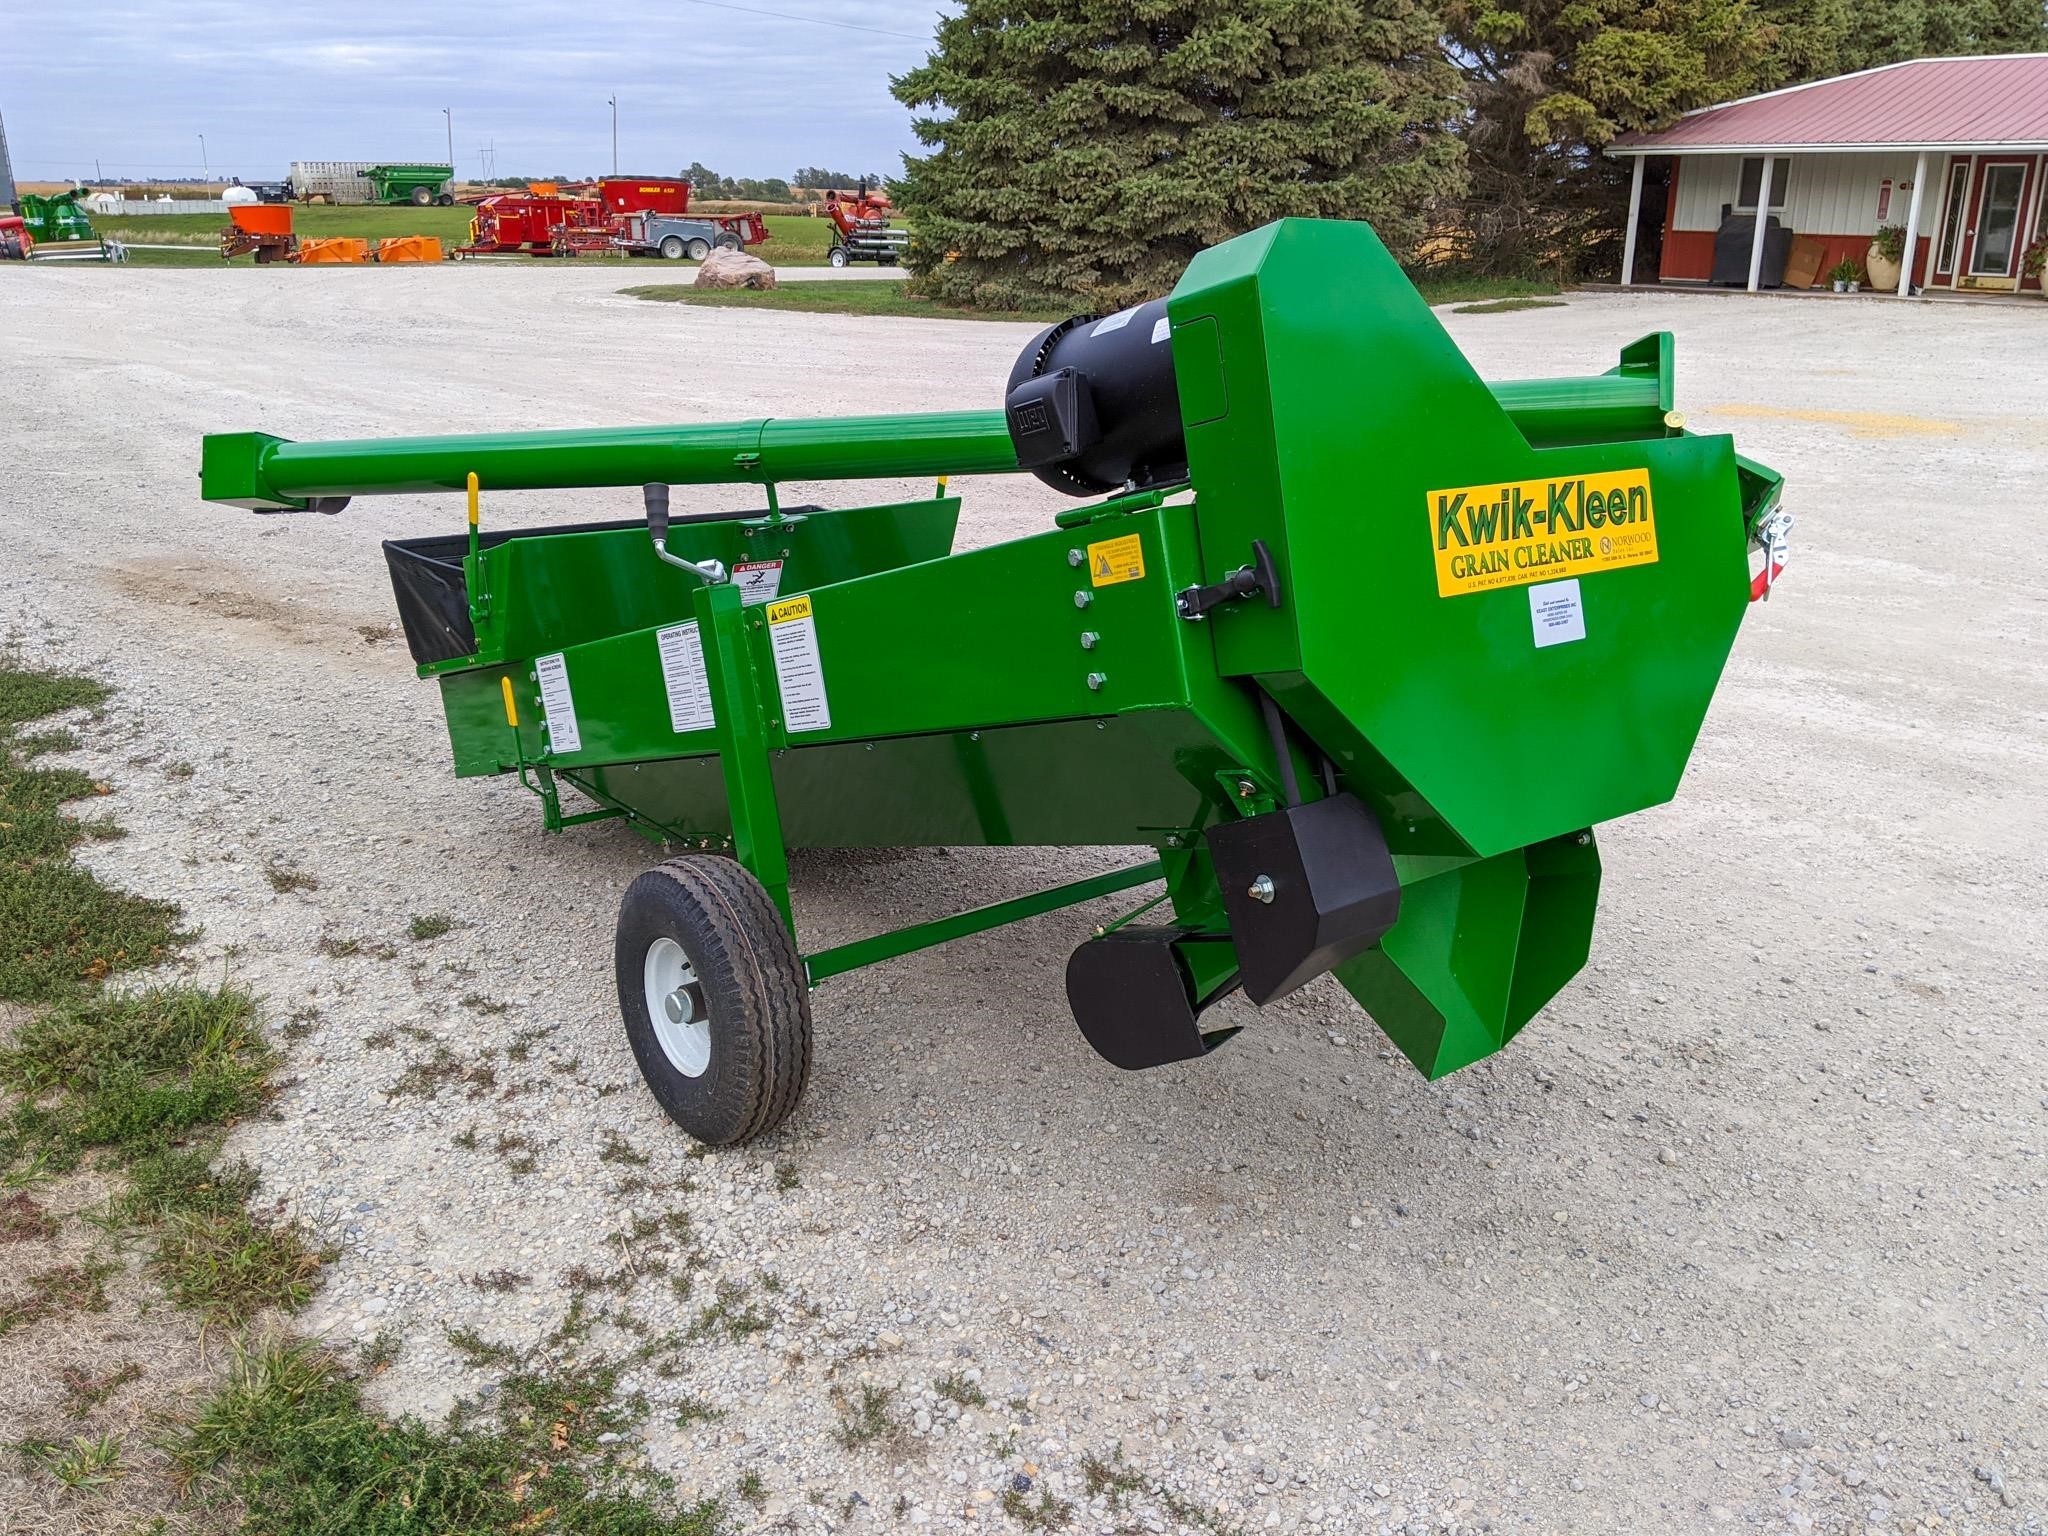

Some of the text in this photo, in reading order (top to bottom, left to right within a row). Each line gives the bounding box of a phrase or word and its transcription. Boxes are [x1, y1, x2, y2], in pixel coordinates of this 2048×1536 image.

[1438, 481, 1648, 550] Kwik-Kleen
[1612, 532, 1652, 546] NORWOOD
[1451, 537, 1594, 578] GRAIN CLEANER
[746, 562, 777, 571] DANGER
[778, 603, 808, 618] CAUTION
